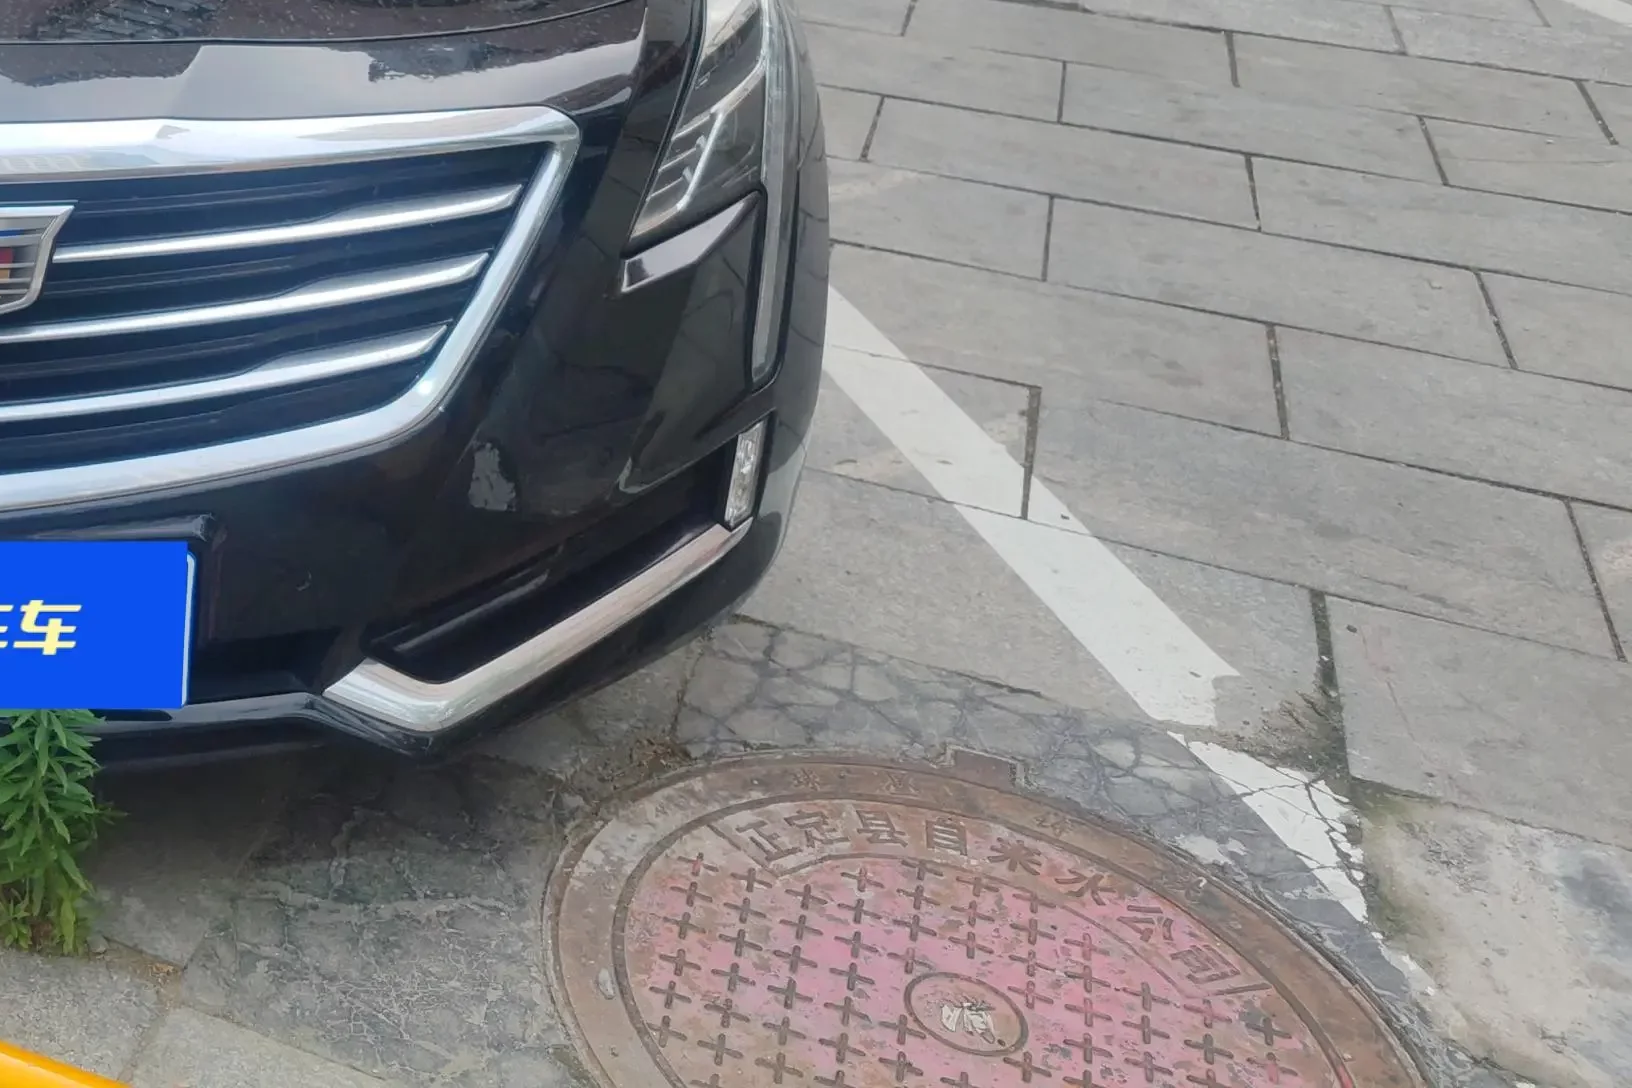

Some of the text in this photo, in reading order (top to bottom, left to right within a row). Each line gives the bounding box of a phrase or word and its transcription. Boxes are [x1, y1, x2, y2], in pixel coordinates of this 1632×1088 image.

[735, 807, 1242, 985] 正定县自来水公司
